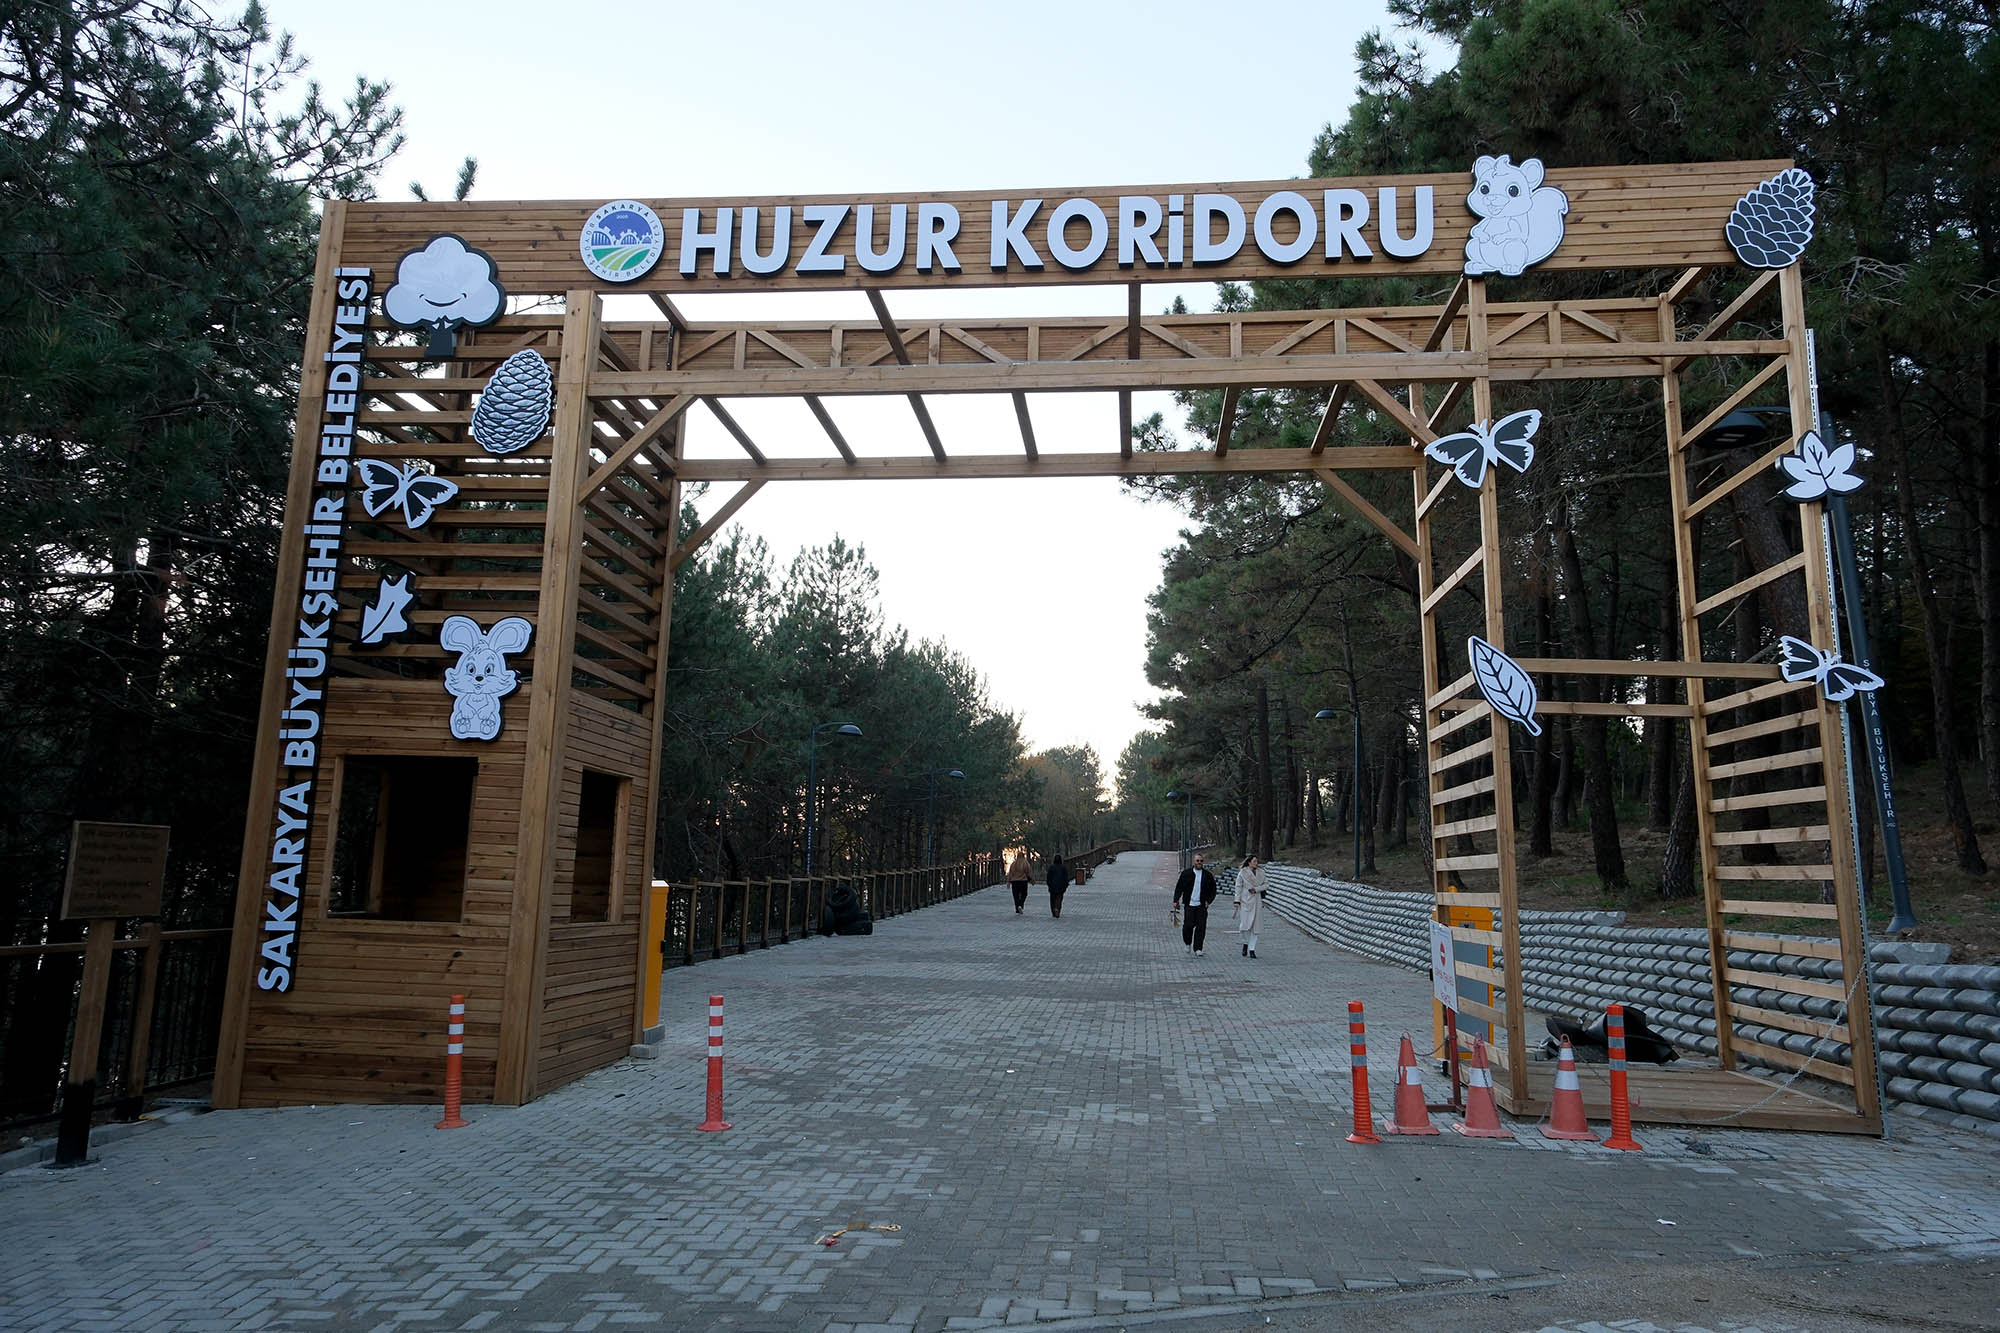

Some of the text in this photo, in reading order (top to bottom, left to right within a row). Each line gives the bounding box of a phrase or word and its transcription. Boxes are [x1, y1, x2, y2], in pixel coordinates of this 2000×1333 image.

[595, 203, 649, 219] SAKARYA
[679, 202, 963, 275] HUZUR
[257, 266, 372, 992] SAKARYA BÜYÜKŞEHİR BELEDİYESİ
